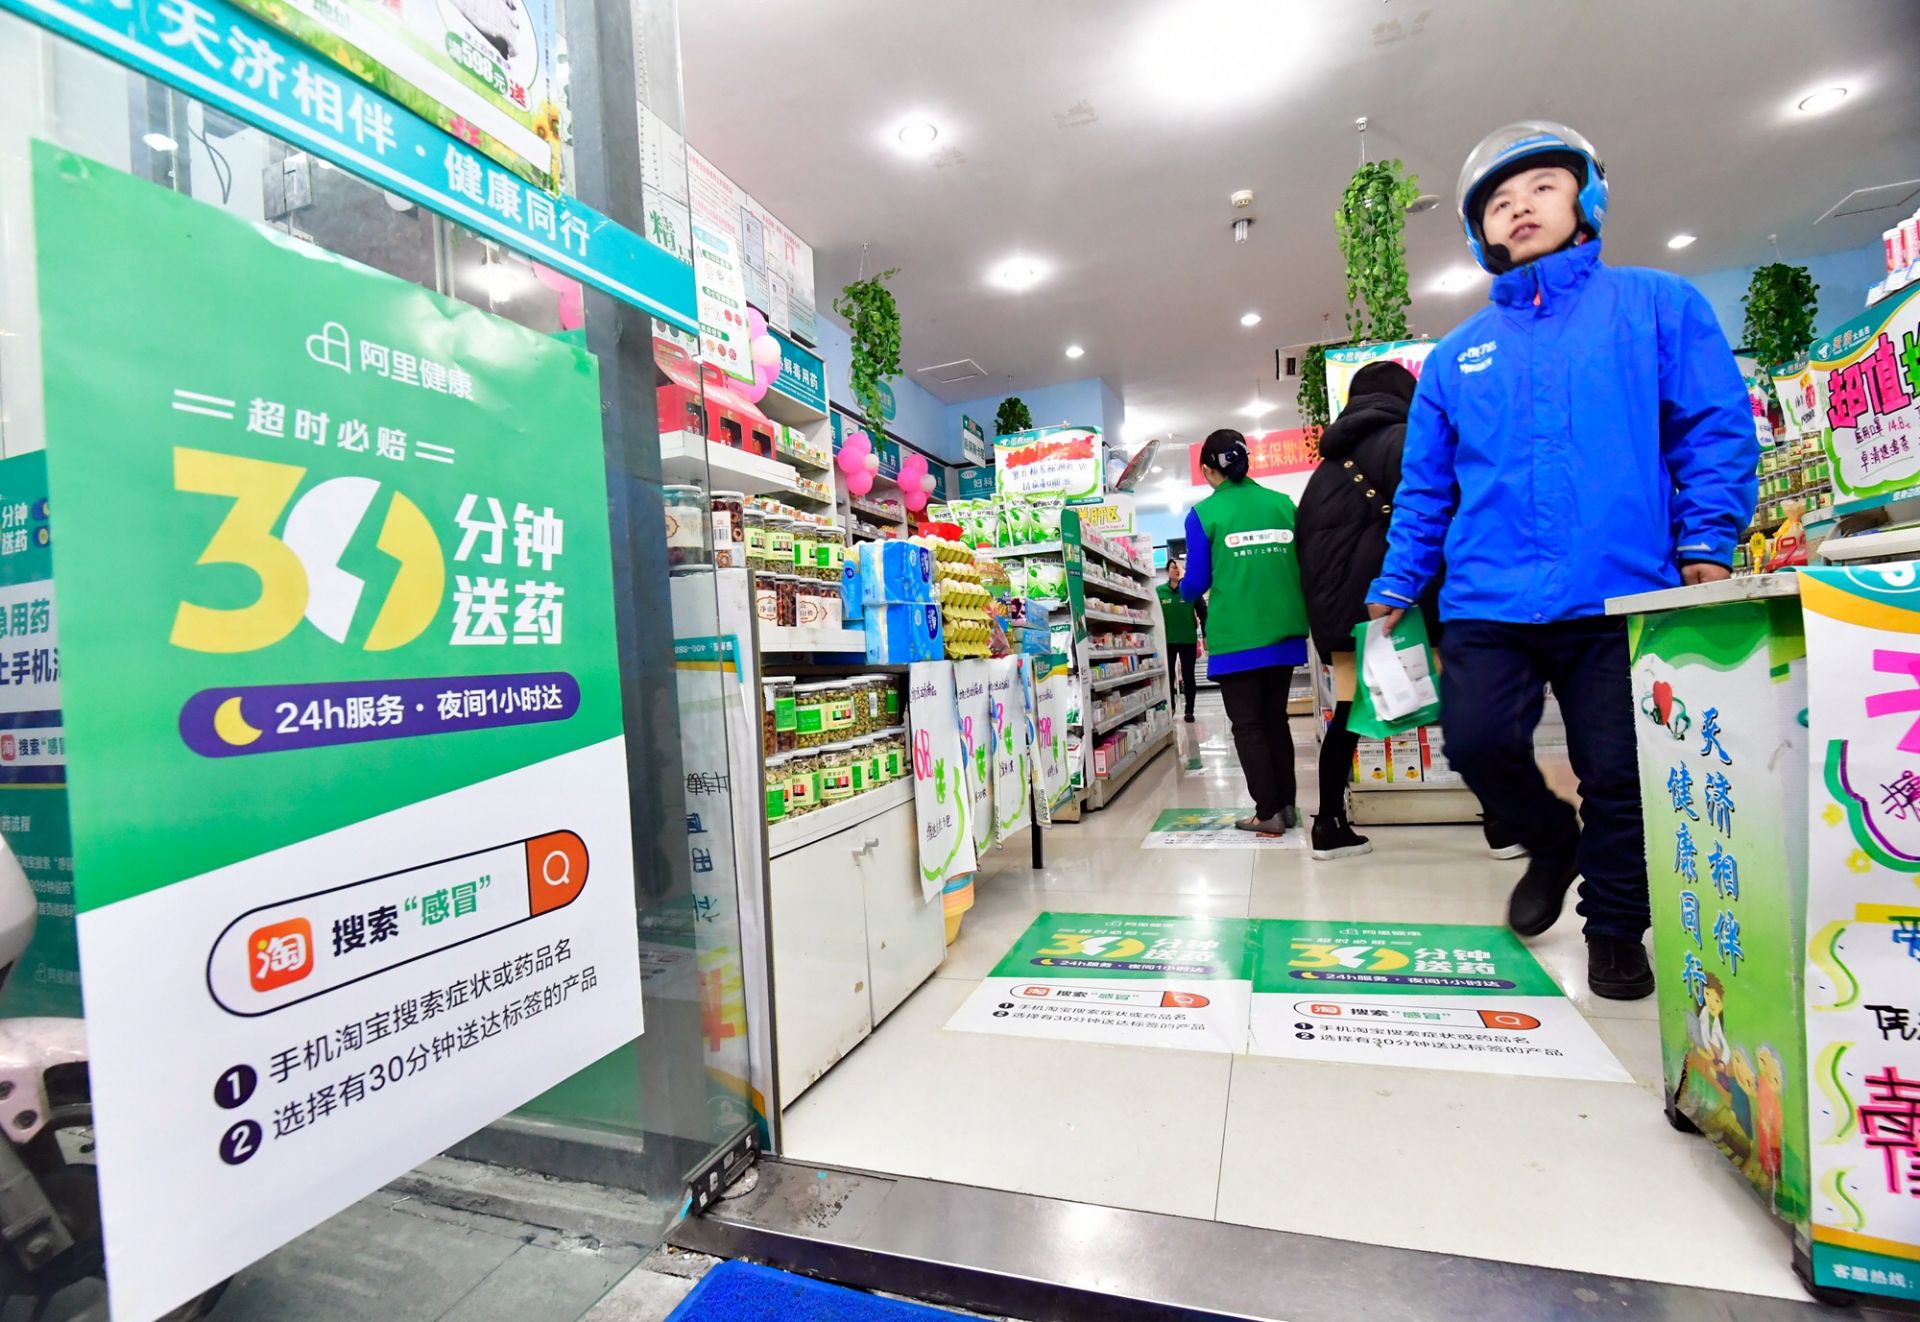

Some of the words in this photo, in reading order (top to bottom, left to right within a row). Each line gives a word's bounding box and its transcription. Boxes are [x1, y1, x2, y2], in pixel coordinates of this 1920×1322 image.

[360, 340, 474, 400] 阿里健康
[246, 397, 407, 462] 超时必赔
[2, 502, 28, 528] 分钟
[2, 529, 28, 556] 送药
[454, 493, 563, 571] 分钟
[169, 446, 445, 653] 30
[448, 574, 563, 645] 送药
[1700, 706, 1744, 976] 天济相伴
[1667, 760, 1707, 1006] 健康同行
[255, 932, 307, 979] 淘
[1288, 943, 1409, 971] 30
[1414, 948, 1491, 962] 分钟
[1414, 960, 1496, 975] 送药
[269, 938, 571, 1084] 手机淘宝搜索症状或药品名
[1320, 1024, 1530, 1044] 手机淘宝搜索症状或药品名
[273, 966, 597, 1139] 选择有30分钟送达标签的产品
